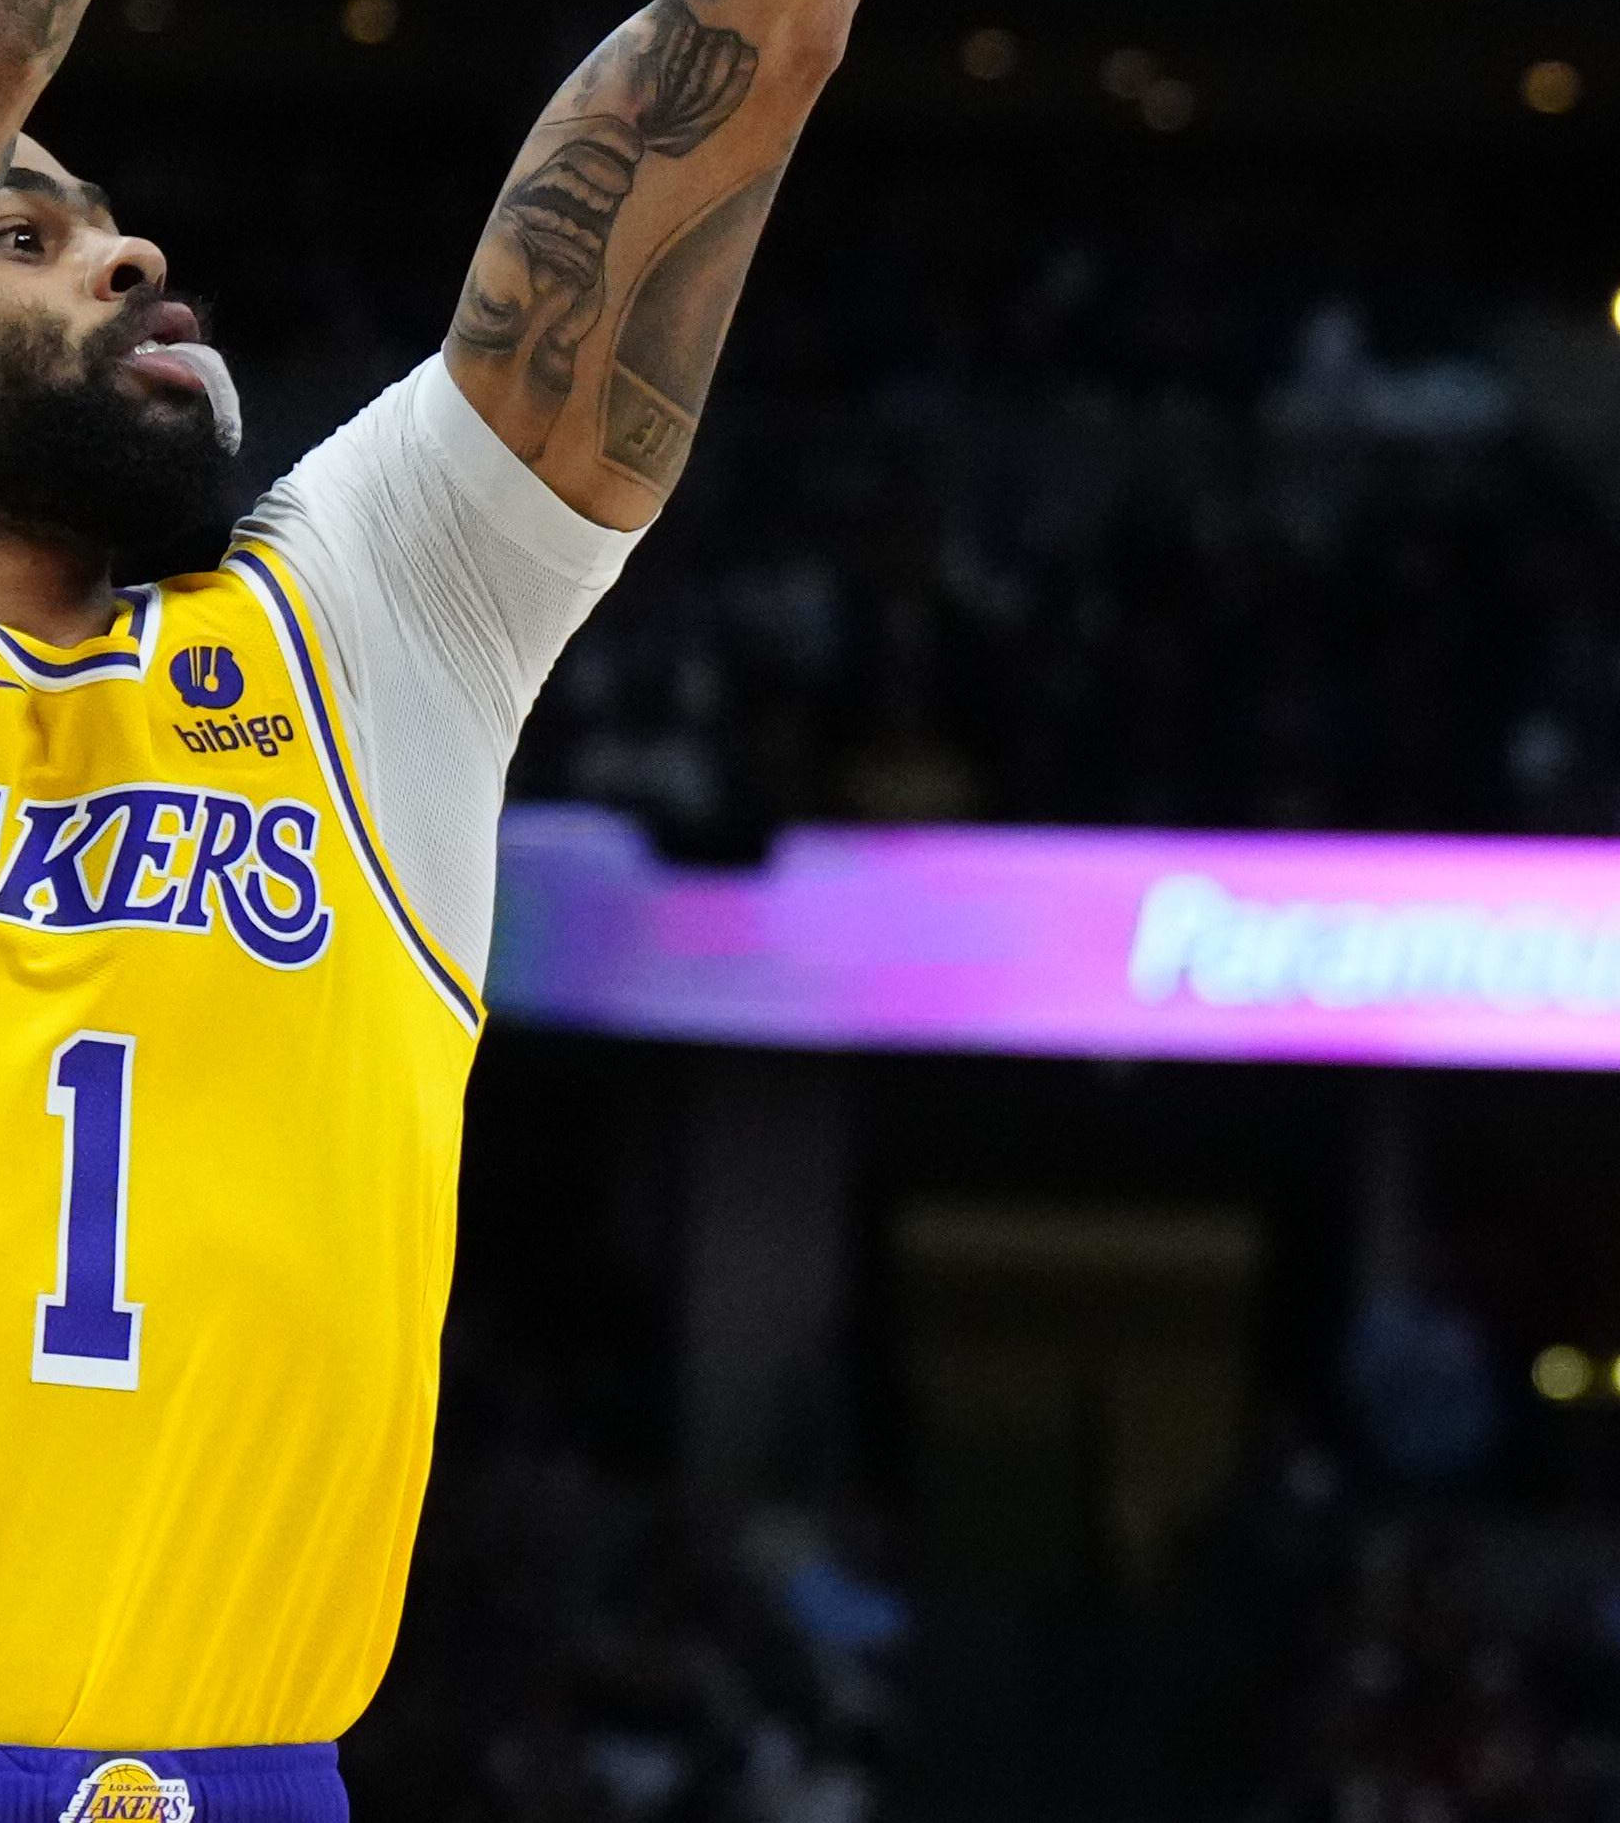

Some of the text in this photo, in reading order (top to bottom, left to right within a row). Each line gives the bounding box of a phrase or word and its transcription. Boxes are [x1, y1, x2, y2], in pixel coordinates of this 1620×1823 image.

[172, 713, 294, 758] bibigo
[31, 1030, 143, 1391] 1
[72, 1782, 187, 1823] LAKERS
[108, 1783, 132, 1793] LOS
